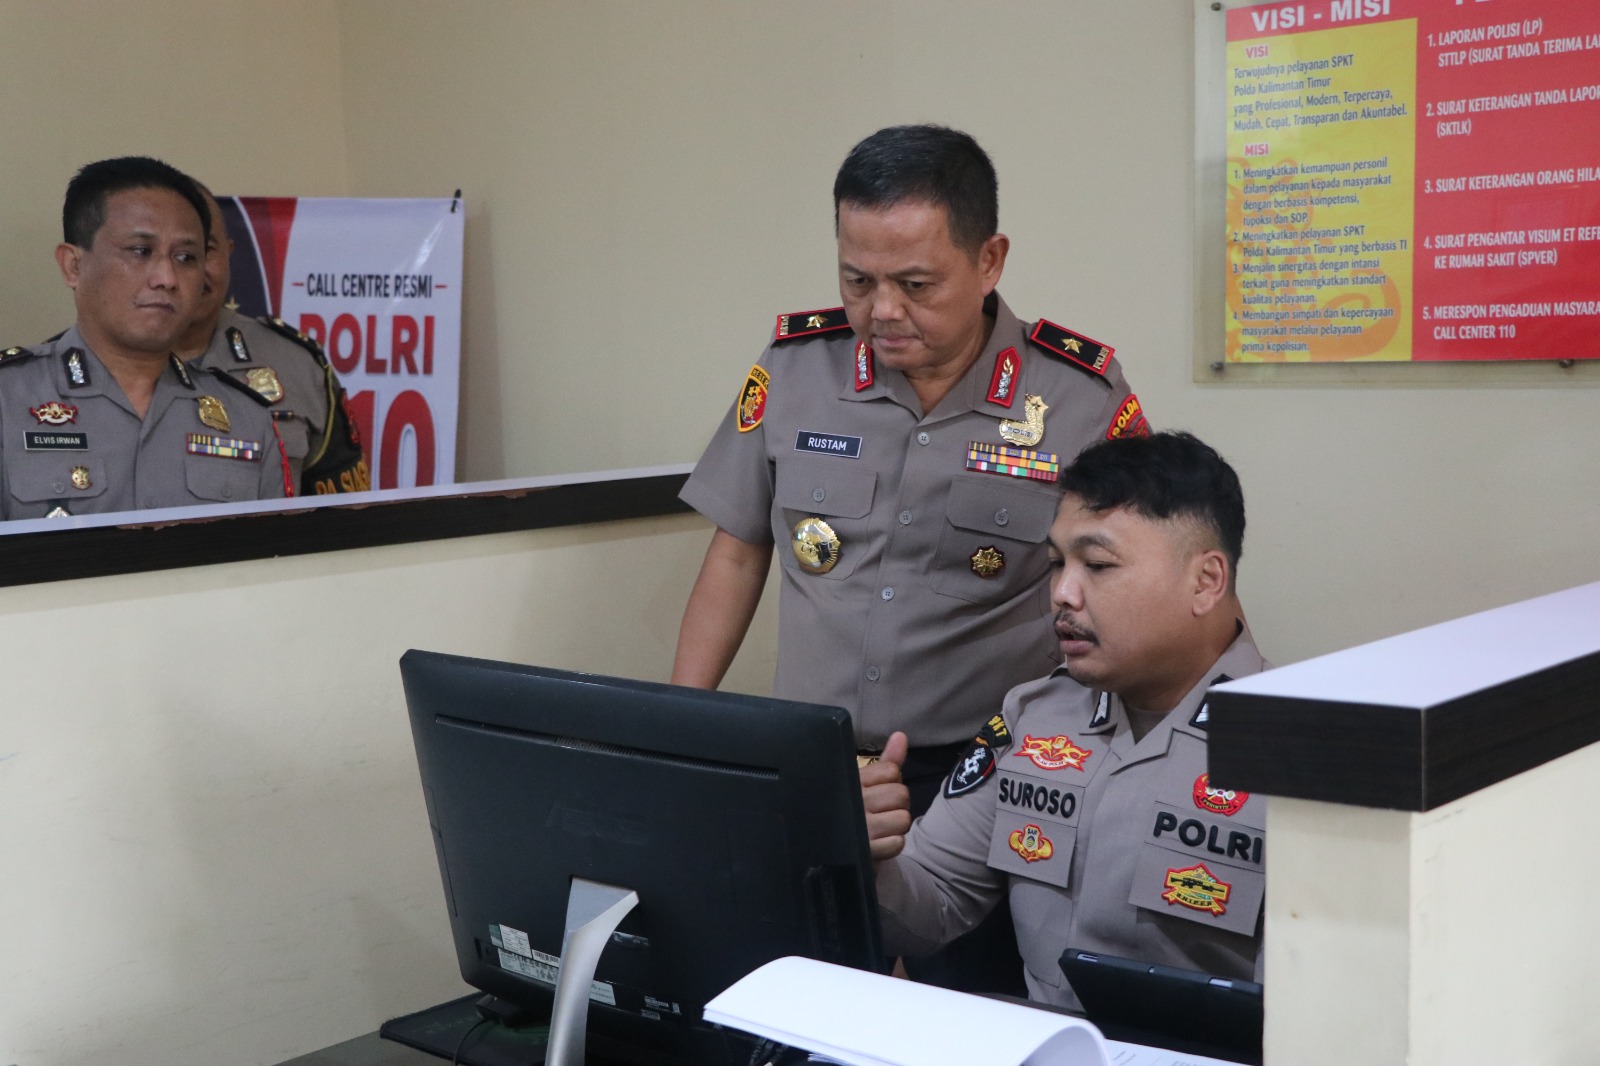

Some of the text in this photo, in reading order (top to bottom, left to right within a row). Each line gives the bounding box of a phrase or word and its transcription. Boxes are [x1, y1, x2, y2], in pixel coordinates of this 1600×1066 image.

[1252, 6, 1304, 32] VISI
[1331, 0, 1390, 22] MISI
[1428, 18, 1542, 47] 1. LAPORAN POLISI (LP)
[1246, 46, 1268, 58] VISI
[1438, 51, 1465, 67] STTLP
[1469, 46, 1504, 65] (SURAT
[1506, 42, 1540, 59] TANDA
[1543, 37, 1583, 55] TERIMA
[1234, 54, 1354, 80] Terwujudnya pelayanan SPKT
[1234, 77, 1331, 96] Polda Kalimantan Timur
[1234, 89, 1393, 117] yang Profesional, Modern, Terpercaya,
[1426, 104, 1434, 116] 2.
[1437, 100, 1467, 116] SURAT
[1469, 93, 1531, 113] KETERANGAN
[1534, 89, 1567, 104] TANDA
[1294, 112, 1340, 127] Transparan
[1342, 108, 1358, 120] dan
[1361, 103, 1407, 119] Akuntabel.
[1437, 118, 1471, 138] (SKTLK)
[1245, 144, 1269, 156] MISI
[1243, 164, 1298, 179] Meningkatkan
[1301, 162, 1350, 175] kemampuan
[1353, 156, 1388, 170] personil
[1244, 174, 1391, 195] dalam pelayanan kepada masyarakat
[1425, 180, 1433, 193] 3.
[1436, 178, 1467, 192] SURAT
[1469, 173, 1534, 190] KETERANGAN
[1537, 169, 1574, 185] ORANG
[1244, 194, 1360, 211] dengan berbasis kompetensi,
[1243, 215, 1272, 227] tupoksi
[1274, 213, 1288, 224] dan
[1242, 229, 1298, 243] Meningkatkan
[1300, 228, 1341, 241] pelayanan
[1344, 226, 1365, 236] SPKT
[1424, 236, 1432, 249] 4.
[1435, 234, 1465, 249] SURAT
[1468, 231, 1525, 247] PENGANTAR
[1528, 229, 1560, 243] VISUM
[1564, 228, 1575, 242] ET
[1244, 240, 1407, 257] Polda Kalimantan Timur yang berbasis TI
[1435, 248, 1557, 269] KE RUMAH SAKIT (SPVER)
[1242, 263, 1275, 274] Menjalin
[1278, 262, 1317, 274] sinergitas
[1319, 260, 1349, 272] dengan
[1351, 259, 1380, 269] intansi
[307, 273, 432, 298] CALL CENTRE RESMI
[1242, 275, 1387, 290] terkait guna meningkatkan standart
[1242, 294, 1317, 306] kualitas pelayanan.
[1242, 310, 1290, 322] Membangun
[1293, 310, 1321, 321] simpati
[1324, 308, 1339, 318] dan
[1341, 308, 1393, 319] kepercayaan
[1423, 308, 1431, 320] 5.
[1434, 305, 1486, 319] MERESPON
[1489, 303, 1551, 318] PENGADUAN
[1242, 325, 1362, 337] masyarakat melalui pelayanan
[1434, 325, 1516, 340] CALL CENTER 110
[299, 313, 435, 375] POLRI
[1242, 342, 1309, 353] prima kepolisian.
[1112, 399, 1139, 436] POLDA
[807, 437, 847, 451] RUSTAM
[999, 778, 1076, 818] SUROSO
[1153, 811, 1263, 864] POLRI
